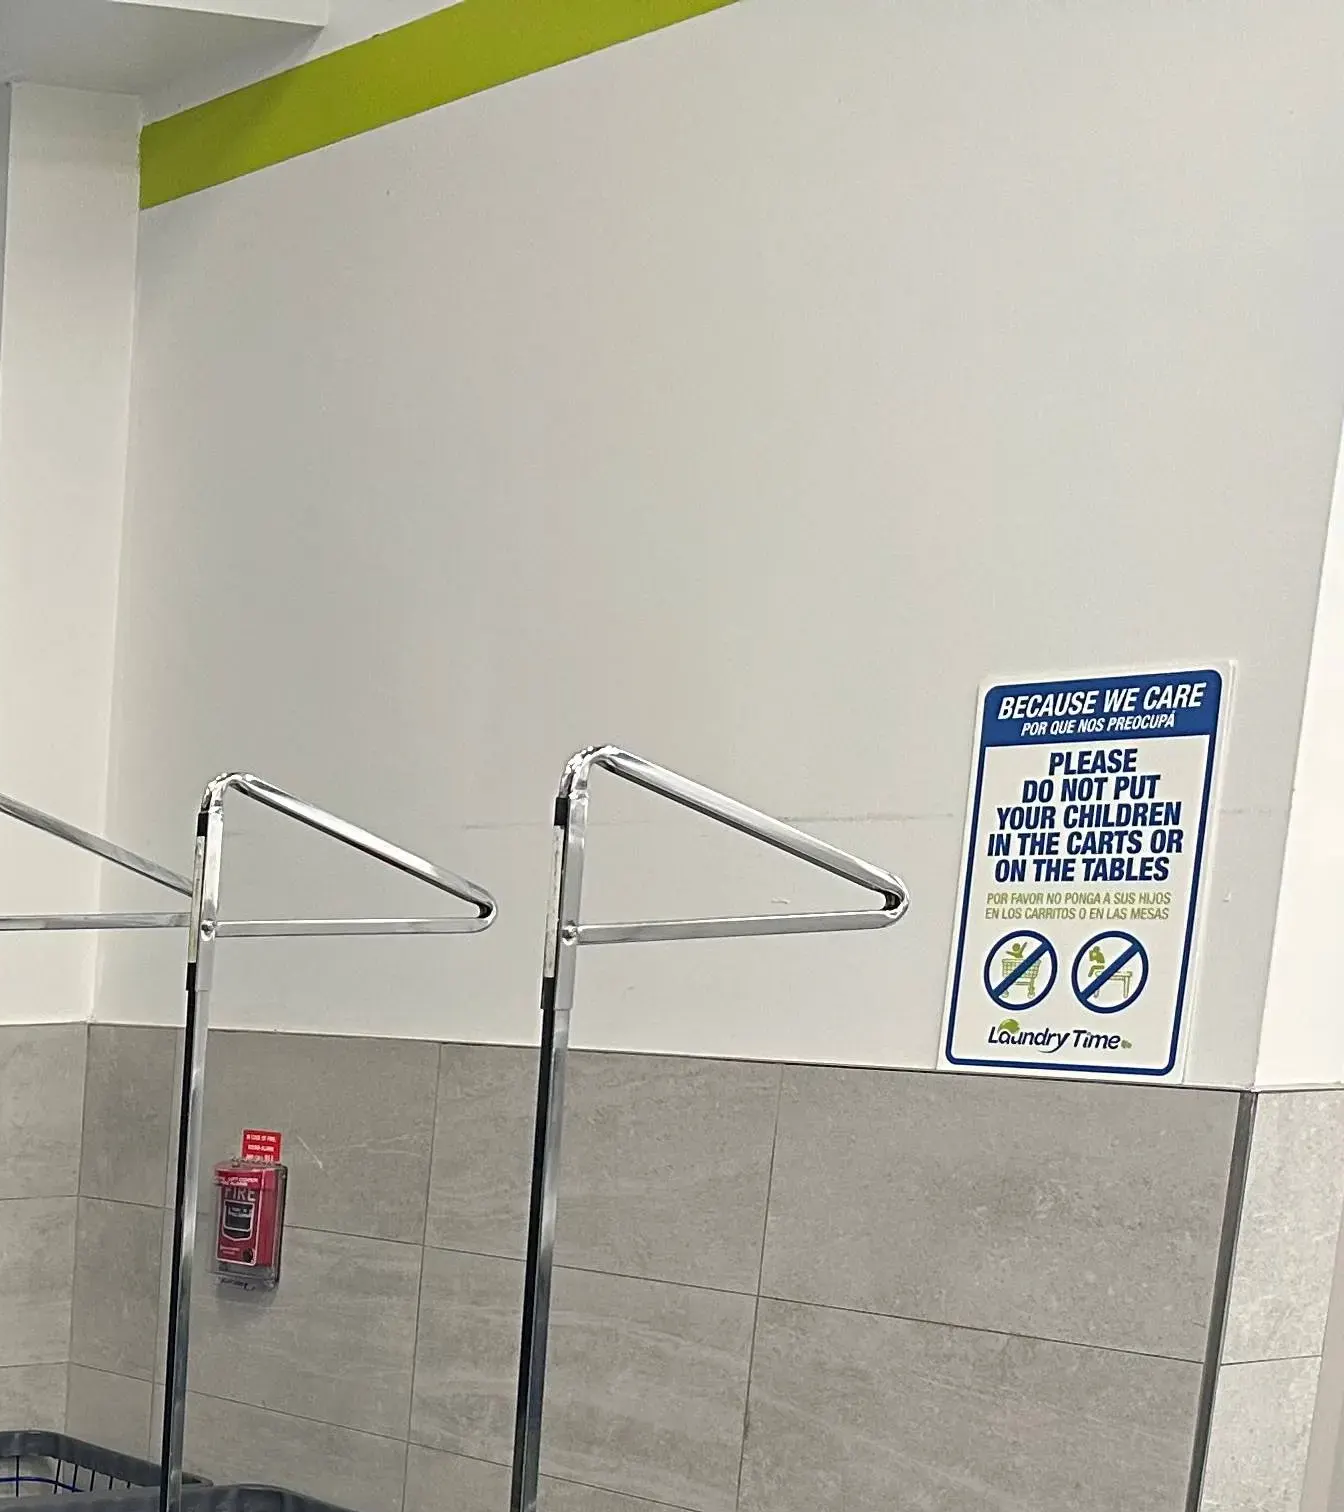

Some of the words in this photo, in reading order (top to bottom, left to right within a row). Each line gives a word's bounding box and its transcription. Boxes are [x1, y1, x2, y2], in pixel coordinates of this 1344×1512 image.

[998, 691, 1098, 720] BECAUSE
[1104, 687, 1140, 713] WE
[1141, 682, 1205, 709] CARE
[1021, 722, 1047, 736] POR
[1049, 720, 1074, 735] QUE
[1077, 718, 1104, 733] NOS
[1049, 749, 1138, 776] PLEASE
[1022, 779, 1053, 803] DO
[1061, 777, 1107, 802] NOT
[1114, 774, 1160, 800] PUT
[997, 805, 1055, 830] YOUR
[1063, 801, 1182, 829] CHILDREN
[987, 833, 1010, 857] IN
[1016, 832, 1060, 856] THE
[1067, 830, 1142, 855] CARTS
[1150, 829, 1184, 853] OR
[995, 859, 1026, 882] ON
[1032, 858, 1075, 882] THE
[1082, 856, 1169, 881] TABLES
[987, 893, 1007, 905] POR
[1011, 893, 1043, 905] FAVOR
[1046, 893, 1062, 905] NO
[1064, 893, 1102, 905] PONGA
[1103, 893, 1111, 905] A
[1113, 893, 1135, 905] SUS
[1138, 892, 1171, 905] HIJOS
[985, 907, 1006, 919] EN
[1007, 907, 1022, 919] LOS
[1024, 907, 1075, 919] CARRITOS
[1079, 907, 1086, 919] O
[1090, 907, 1105, 919] EN
[1106, 907, 1127, 919] LAS
[1130, 907, 1169, 919] MESAS
[988, 1027, 1070, 1053] Laundry
[1072, 1029, 1121, 1049] Time
[224, 1187, 256, 1201] FIRE
